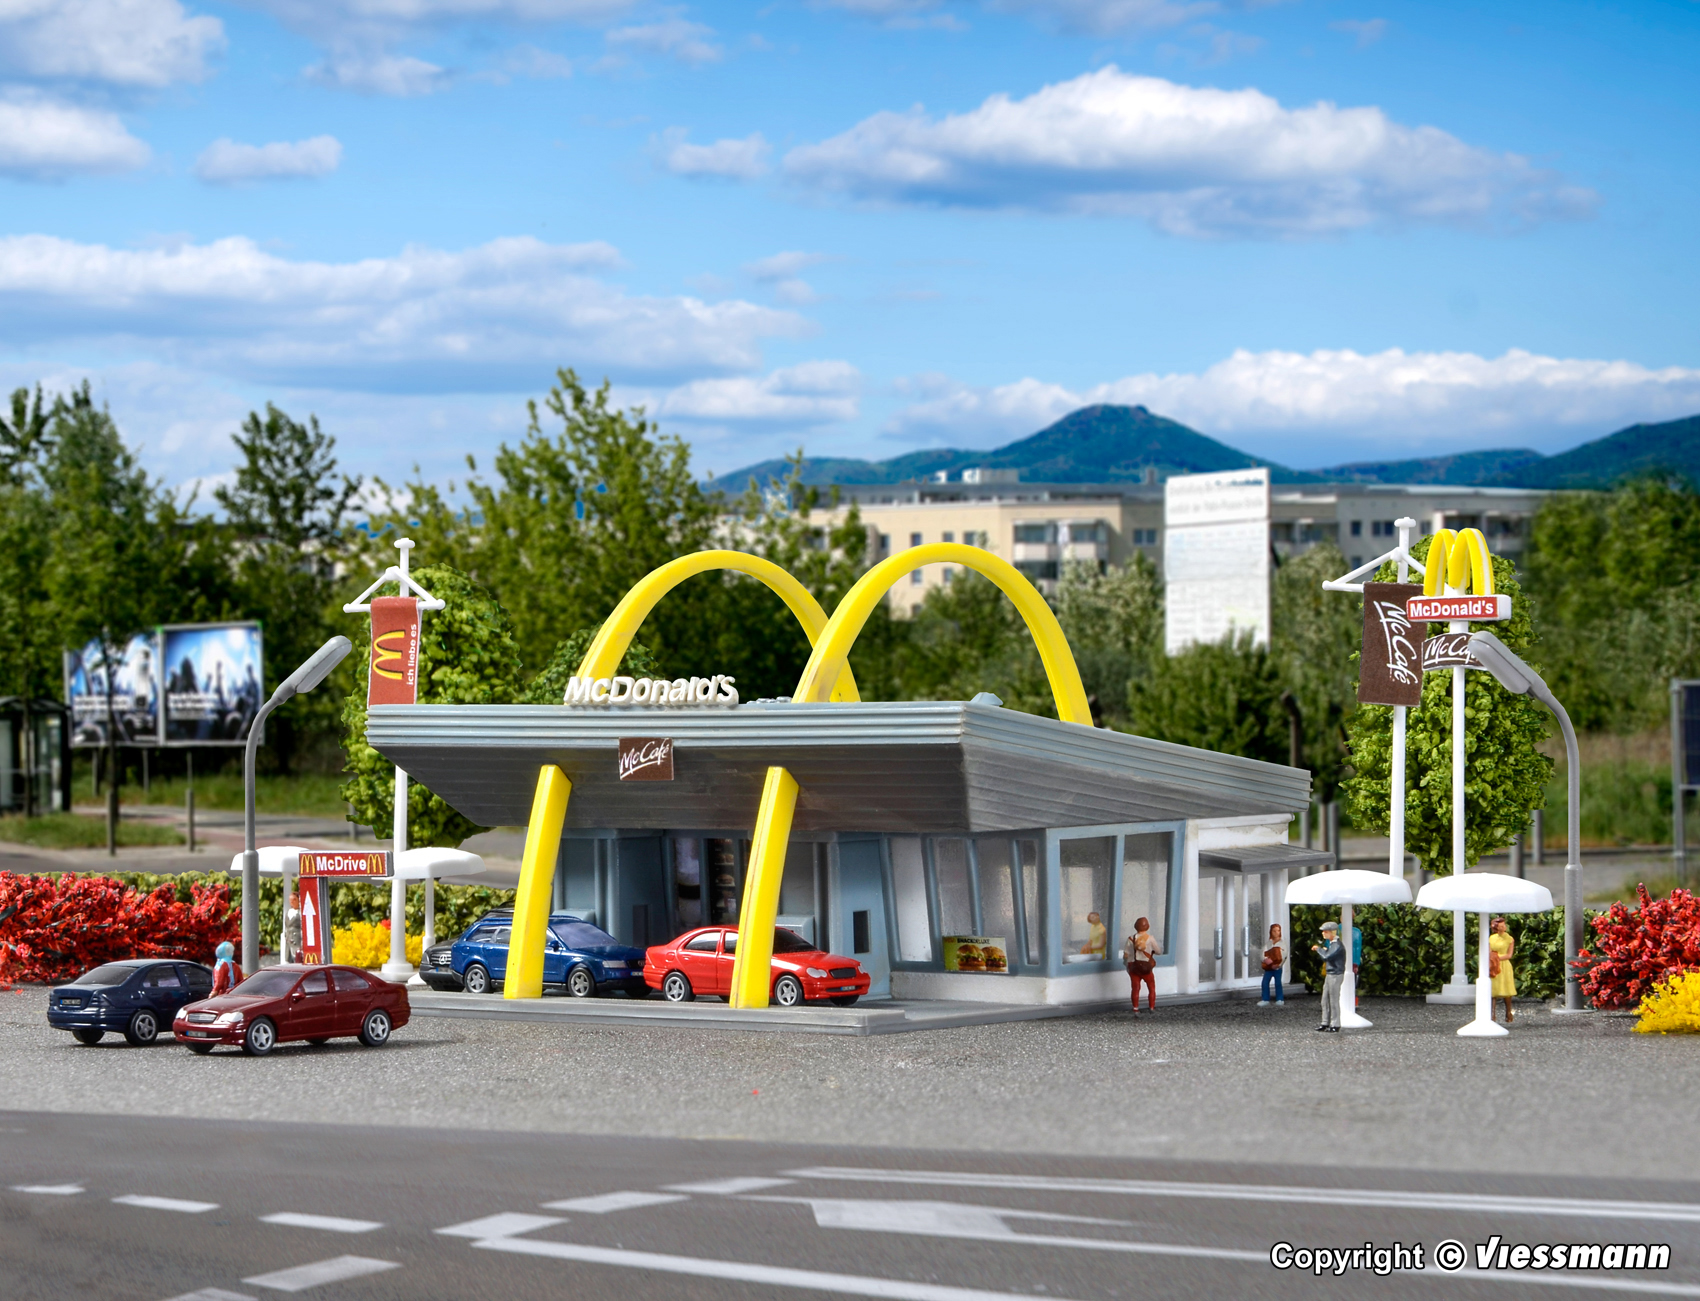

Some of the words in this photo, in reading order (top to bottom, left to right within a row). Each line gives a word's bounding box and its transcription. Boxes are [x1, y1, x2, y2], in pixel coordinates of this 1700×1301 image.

[1410, 601, 1494, 617] McDonald's
[411, 624, 417, 637] es
[1374, 601, 1419, 685] McCafé
[408, 640, 417, 667] liebe
[1424, 635, 1476, 664] McCa
[406, 669, 415, 686] ich
[564, 675, 739, 706] McDonald's
[620, 738, 669, 775] McCafé
[316, 856, 367, 871] McDrive
